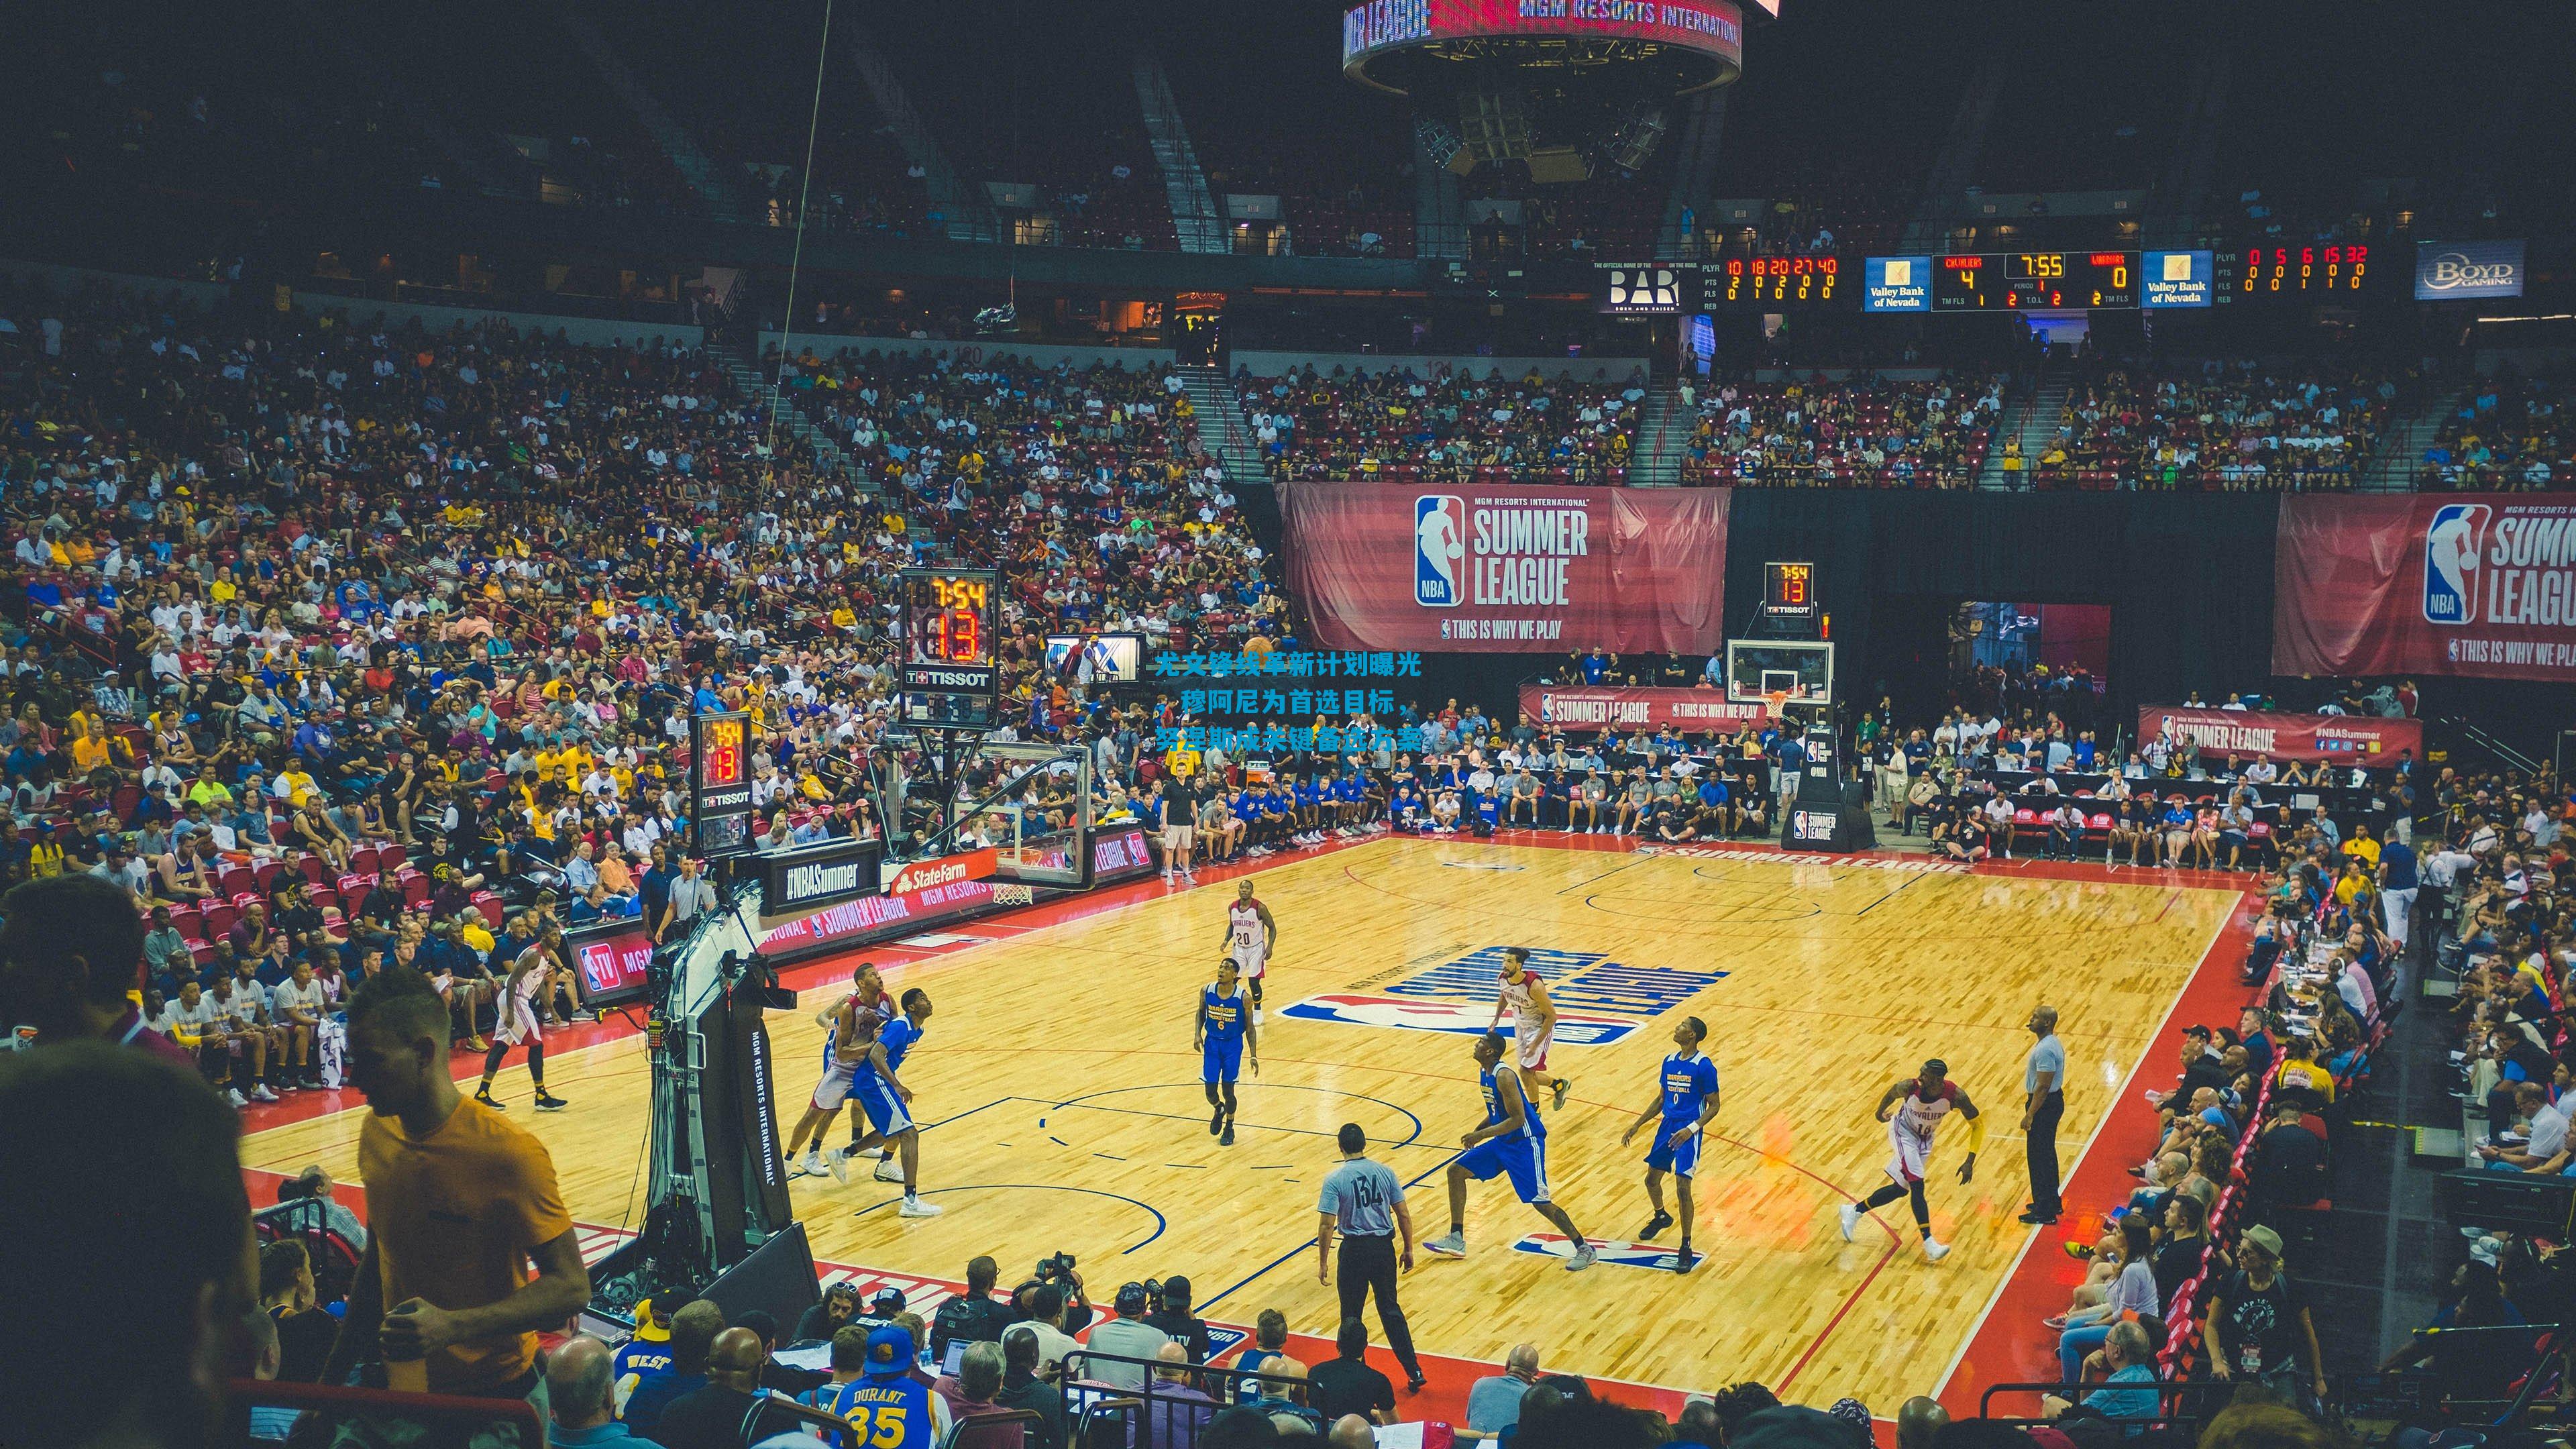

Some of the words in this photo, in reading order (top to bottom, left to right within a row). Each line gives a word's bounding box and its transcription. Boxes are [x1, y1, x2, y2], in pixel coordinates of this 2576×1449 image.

[1519, 0, 1566, 17] MGM
[1573, 0, 1655, 23] RESORTS
[2021, 256, 2061, 276] 7:55
[2216, 254, 2236, 262] PLYR
[1702, 264, 1720, 272] PLYR
[1727, 260, 1742, 276] 10
[1752, 260, 1766, 275] 18
[1770, 260, 1788, 274] 20
[1794, 260, 1813, 274] 27
[1818, 259, 1837, 274] 40
[2436, 262, 2514, 282] BOYD
[1961, 270, 1974, 289] 4
[2114, 267, 2127, 288] 0
[2461, 276, 2513, 287] GAMING
[1870, 287, 1898, 297] Valley
[1900, 286, 1924, 296] Bank
[2148, 282, 2177, 292] Valley
[2180, 282, 2206, 291] Bank
[1874, 299, 1884, 307] of
[1886, 298, 1920, 307] Nevada
[2008, 294, 2017, 306] 2
[2053, 293, 2061, 305] 2
[2093, 291, 2102, 305] 2
[2152, 294, 2162, 303] of
[2165, 293, 2201, 303] Nevada
[1475, 498, 1492, 506] MGM
[1494, 498, 1527, 506] RESORTS
[1529, 498, 1587, 507] INTERNATIONAL
[1474, 509, 1587, 556] SUMMER
[1475, 557, 1569, 605] LEAGUE
[1780, 566, 1808, 580] 7:54
[932, 579, 986, 610] 7:54
[1421, 580, 1444, 598] NBA
[1784, 581, 1803, 602] 13
[2430, 594, 2455, 614] NBA
[938, 612, 977, 661] 13
[1452, 619, 1477, 638] THIS
[1479, 619, 1489, 639] IS
[1491, 620, 1516, 639] WHY
[1518, 620, 1534, 639] WE
[1537, 620, 1562, 639] PLAY
[2461, 639, 2489, 661] THIS
[2491, 641, 2504, 663] IS
[2506, 642, 2534, 665] WHY
[2536, 643, 2555, 665] WE
[929, 672, 989, 687] TISSOT
[1556, 702, 1606, 722] SUMMER
[1609, 702, 1650, 723] LEAGUE
[1680, 703, 1698, 718] THIS
[1699, 704, 1707, 718] IS
[1708, 704, 1725, 718] WHY
[1727, 704, 1739, 718] WE
[1739, 704, 1758, 719] PLAY
[2232, 725, 2276, 752] LEAGUE
[2316, 727, 2381, 740] #NBASummer
[717, 749, 736, 780] 13
[1811, 767, 1827, 777] @NBA
[716, 792, 750, 806] TISSOT
[1808, 815, 1836, 828] SUMMER
[1808, 827, 1831, 840] LEAGUE
[1099, 839, 1128, 871] LEAGUE
[1669, 848, 1833, 865] SUMMER
[1834, 857, 1976, 875] LEAGUE
[787, 863, 859, 900] #NBASummer
[922, 890, 945, 906] MGM
[822, 896, 873, 934] SUMMER
[872, 896, 910, 924] LEAGUE
[1236, 932, 1250, 945] 20
[594, 953, 614, 980] TV
[623, 948, 653, 973] MGM
[1208, 1004, 1237, 1014] WARRIORS
[1218, 1021, 1225, 1030] 6
[751, 1031, 761, 1057] MGM
[753, 1058, 765, 1104] RESORTS
[1673, 1093, 1678, 1105] 0
[759, 1106, 775, 1186] INTERNATIONAL
[1351, 1174, 1384, 1209] 134
[627, 1354, 671, 1370] WEST
[853, 1387, 907, 1404] DURANT
[840, 1406, 907, 1449] 35
